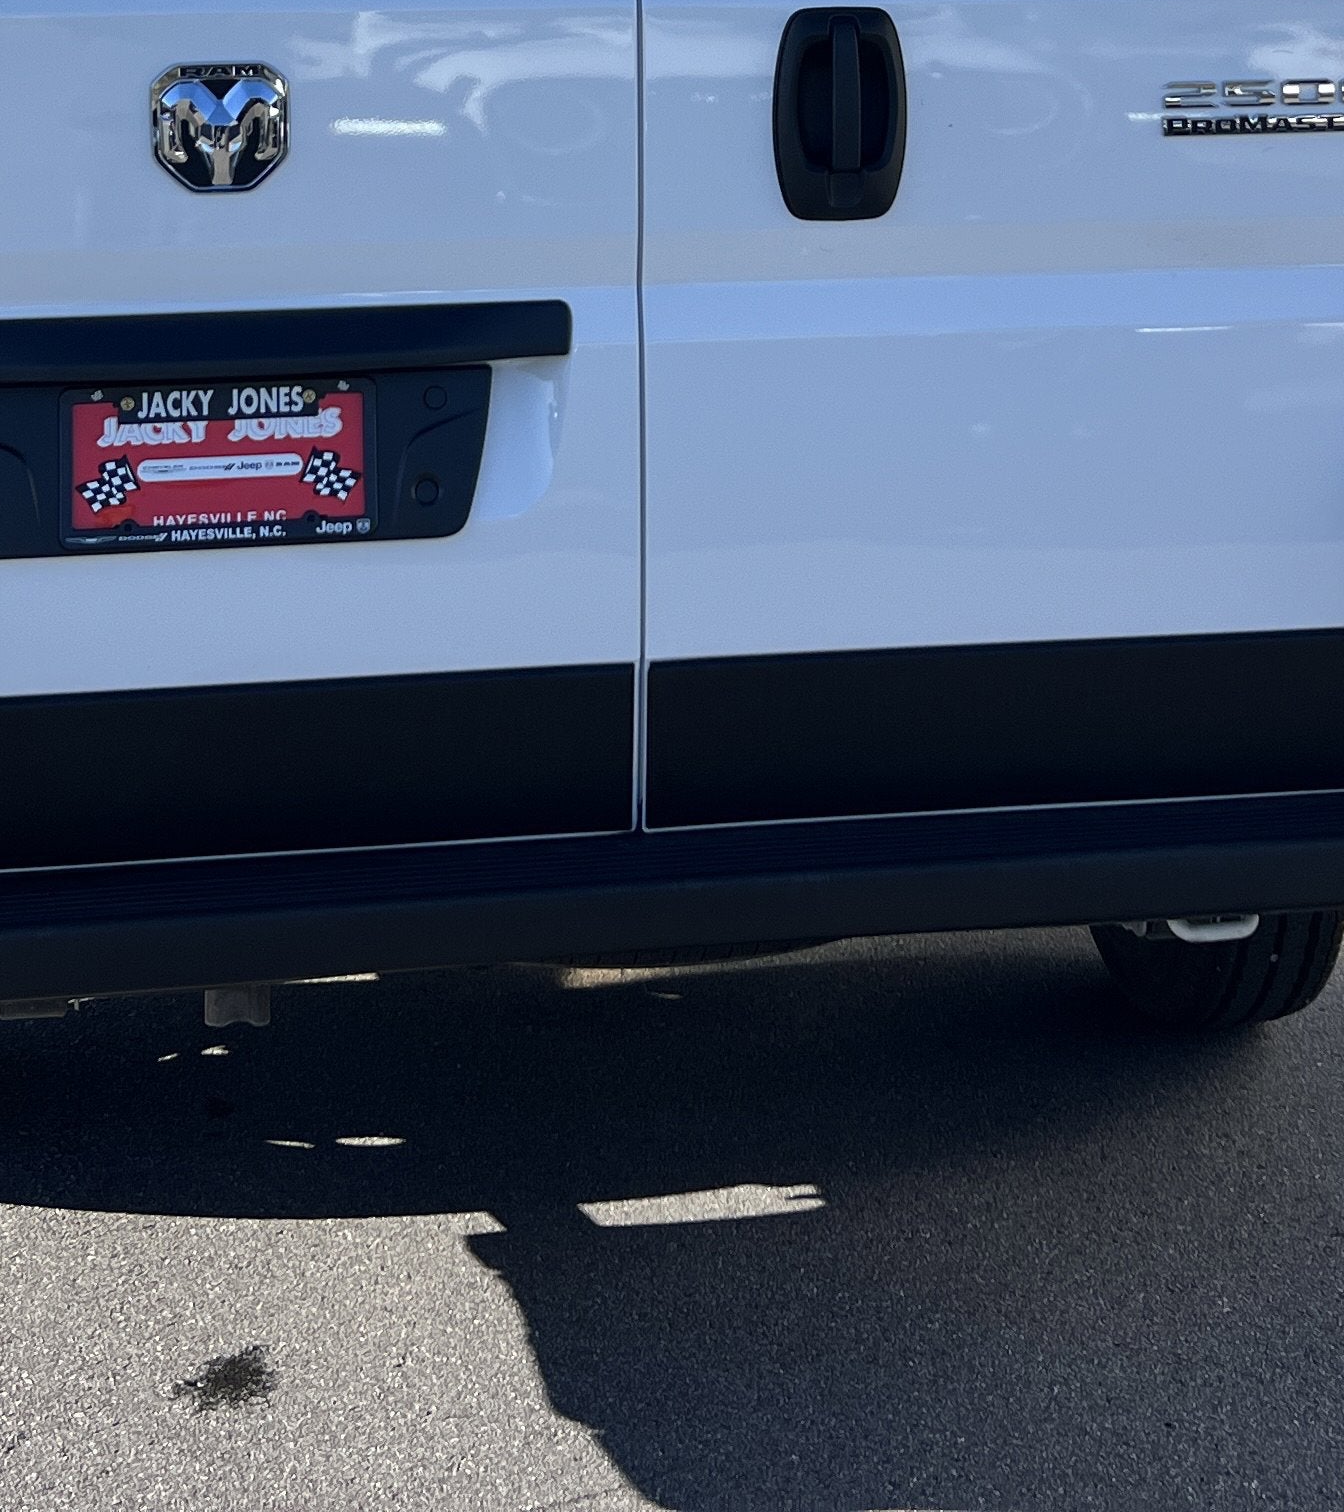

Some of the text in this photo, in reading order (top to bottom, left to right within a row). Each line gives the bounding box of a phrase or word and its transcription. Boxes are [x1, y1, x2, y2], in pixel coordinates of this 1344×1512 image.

[137, 385, 305, 419] JACKY JONES
[236, 460, 263, 470] Jeep
[171, 526, 256, 542] HAYESVILLE,
[259, 525, 287, 538] N.C.
[316, 520, 353, 534] Jeep
